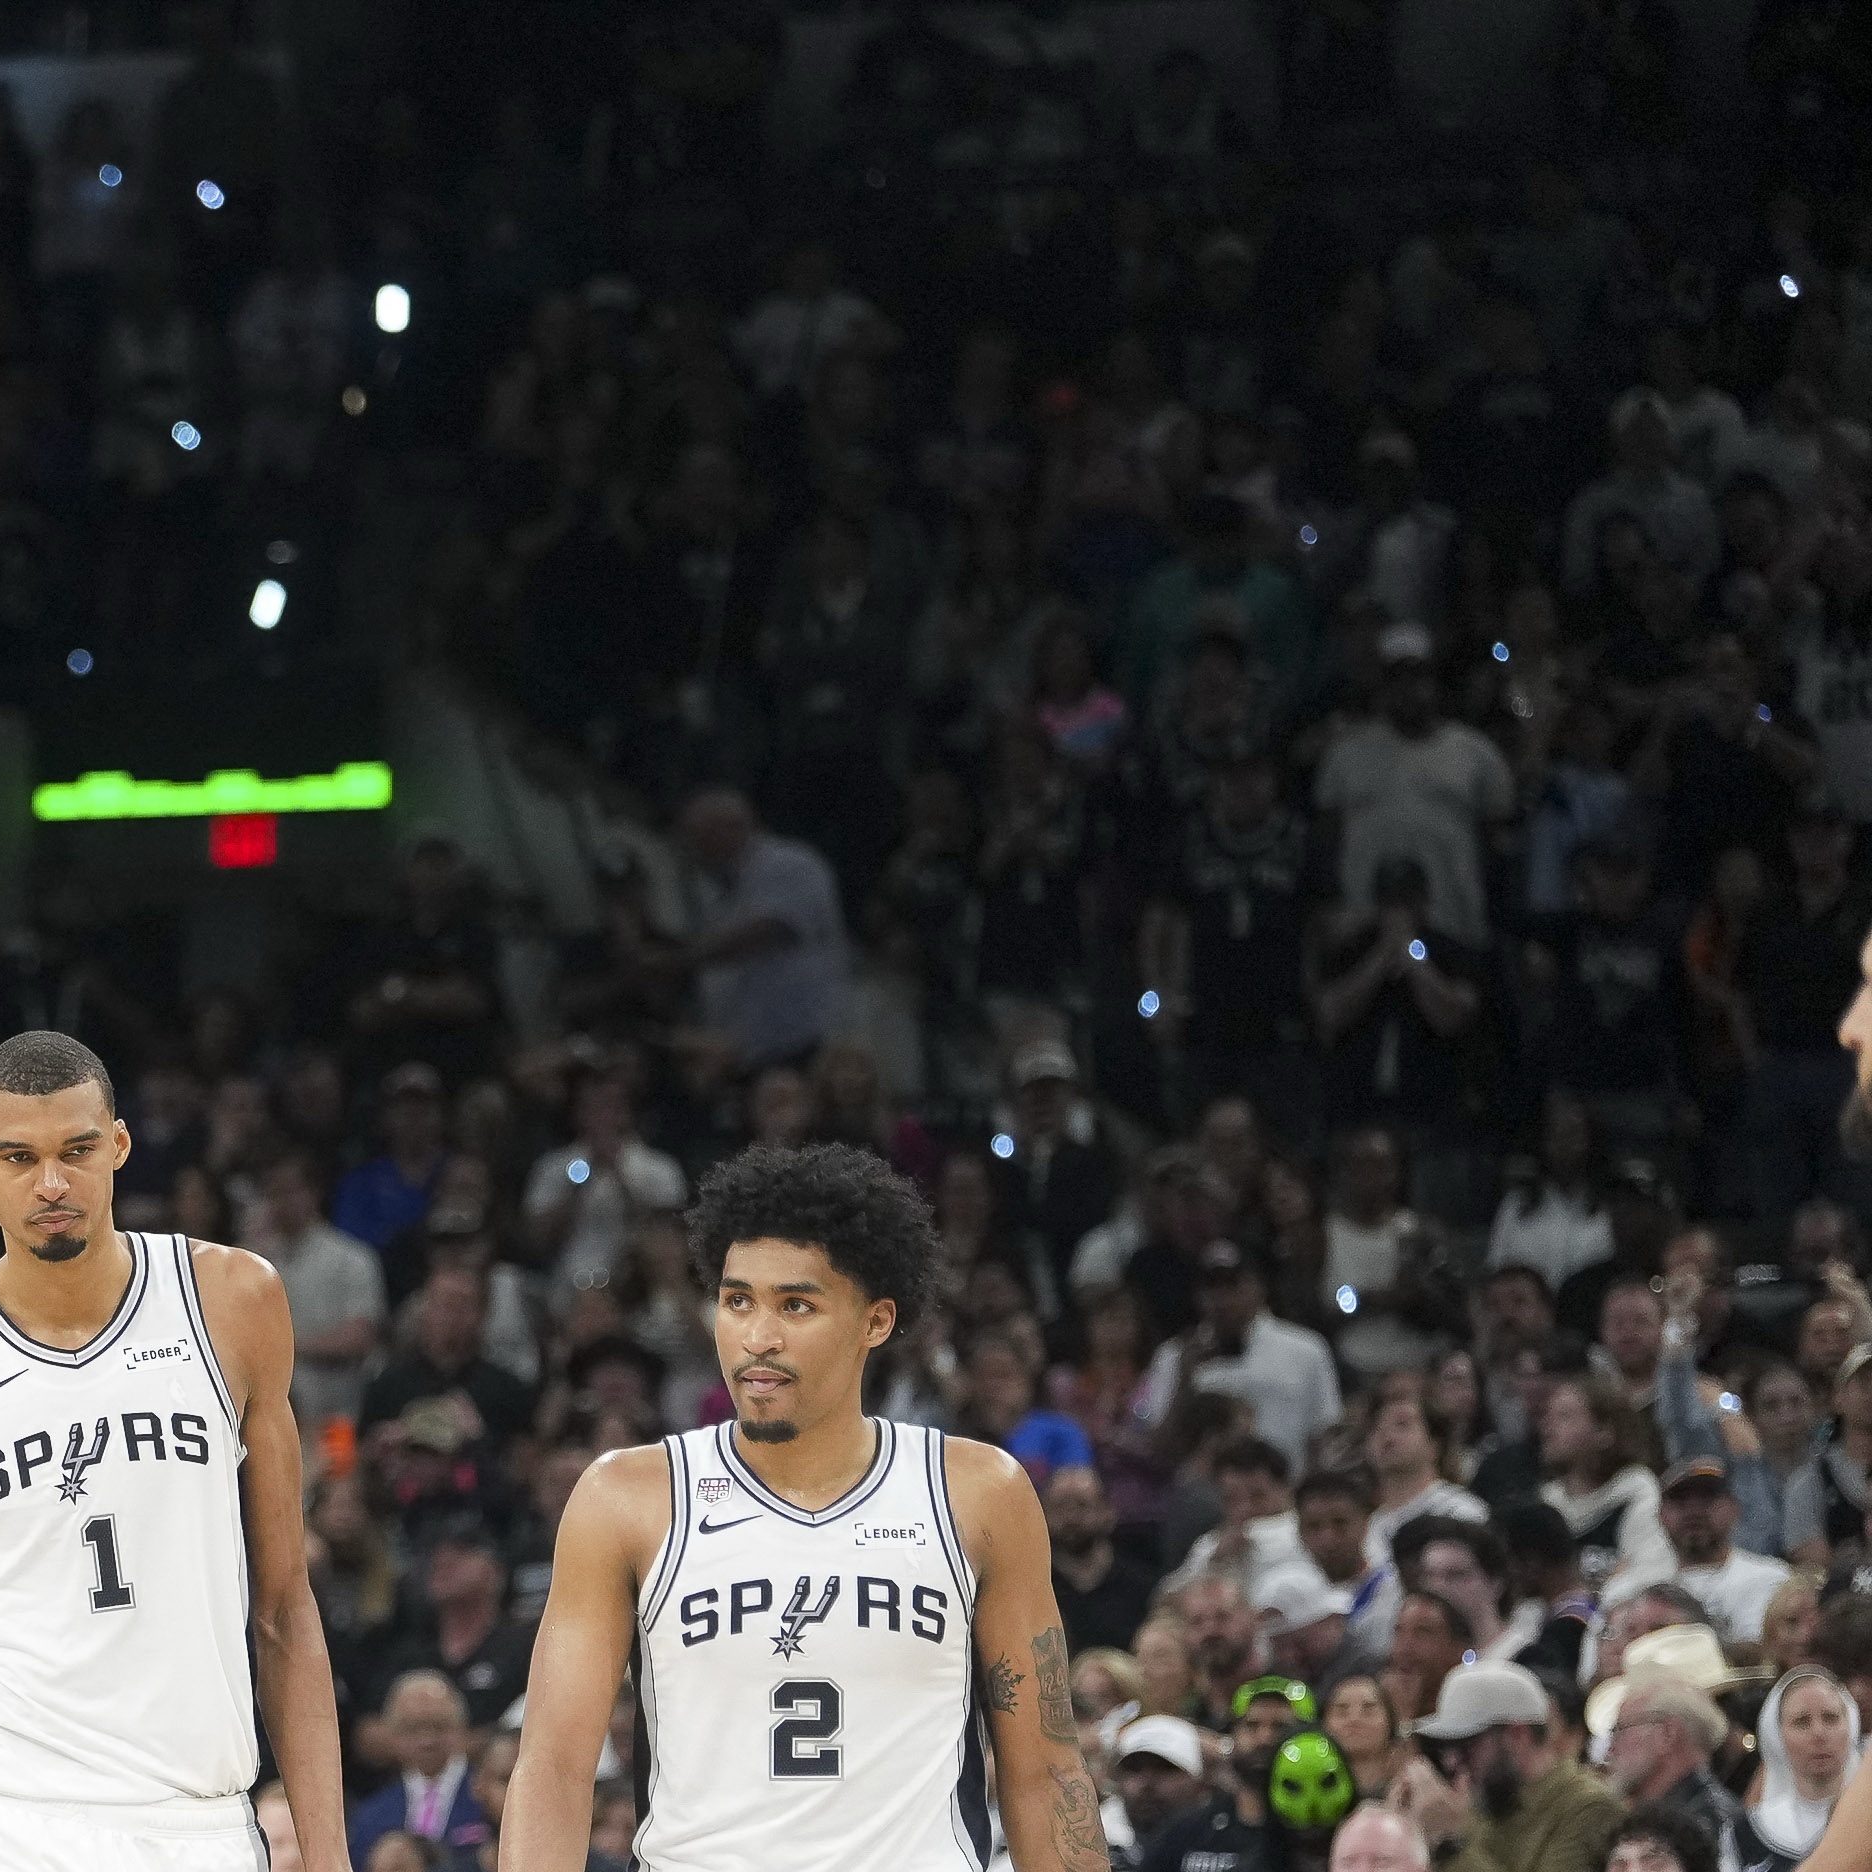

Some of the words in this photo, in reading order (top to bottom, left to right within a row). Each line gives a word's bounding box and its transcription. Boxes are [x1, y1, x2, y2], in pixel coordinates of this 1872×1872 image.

[132, 1345, 182, 1362] LEDGER
[696, 1490, 729, 1500] 250
[863, 1528, 917, 1540] LEDGER
[80, 1513, 136, 1614] 1
[680, 1575, 948, 1663] SPURS
[769, 1677, 844, 1781] 2
